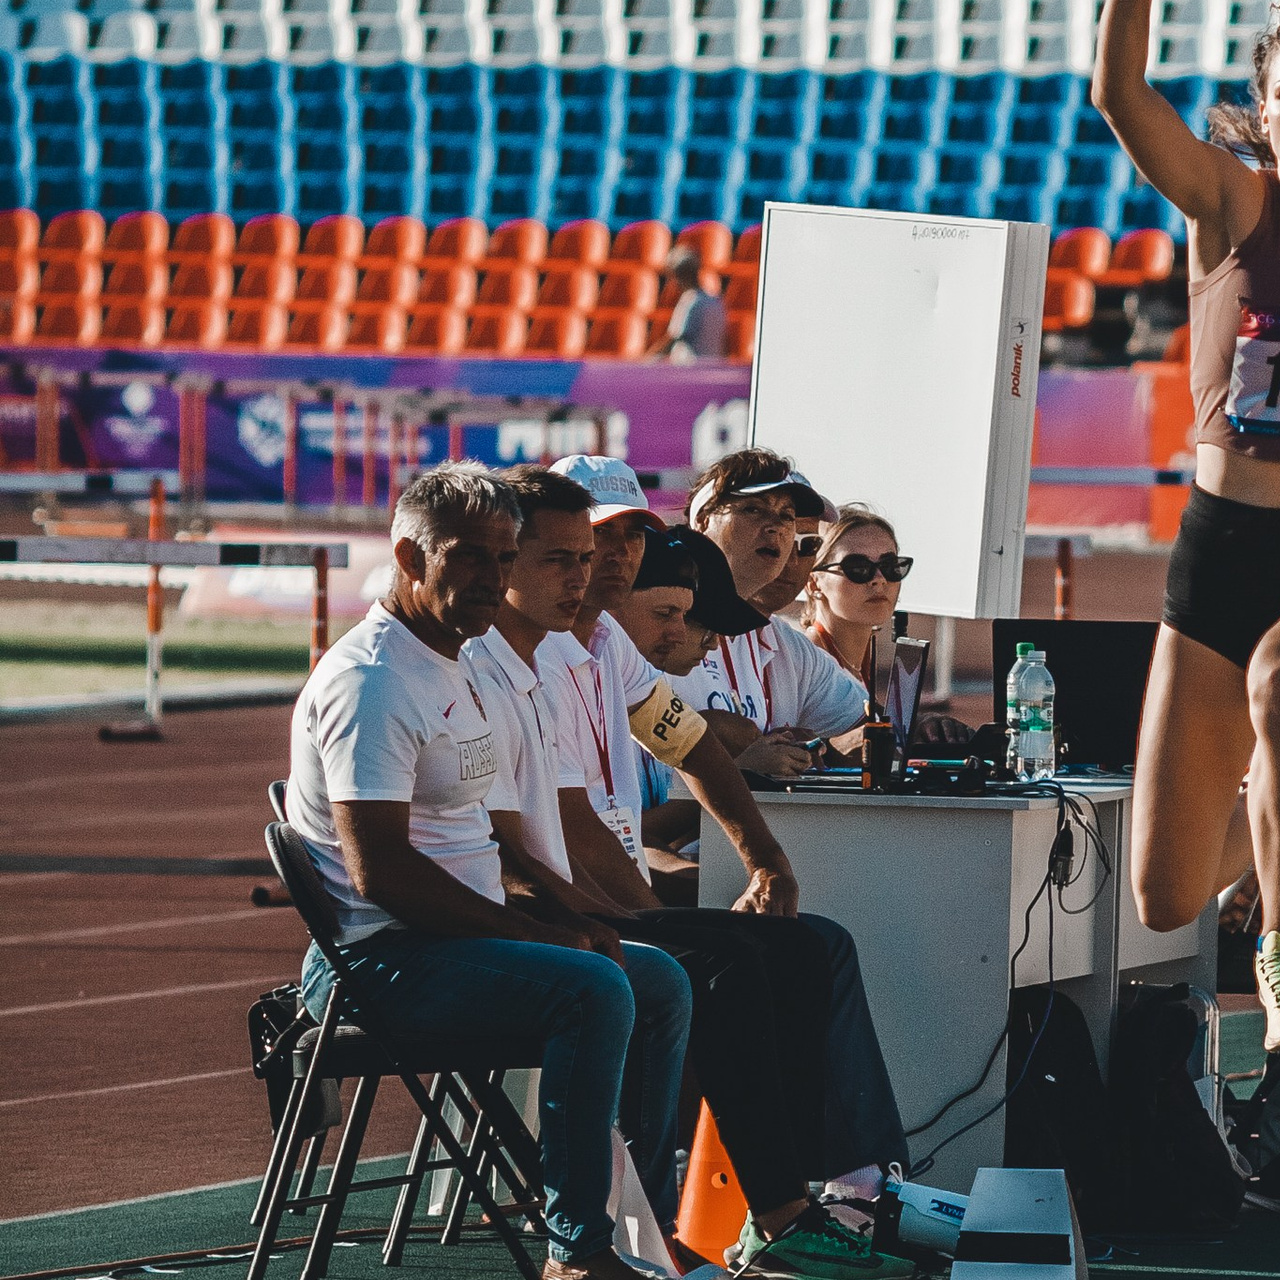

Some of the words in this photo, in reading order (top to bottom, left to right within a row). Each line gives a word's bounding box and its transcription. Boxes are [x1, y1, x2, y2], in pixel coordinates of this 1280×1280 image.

[1010, 342, 1023, 398] polanik
[589, 475, 638, 497] RUSSIA
[652, 689, 685, 742] РЕФ
[457, 731, 498, 781] RUSS
